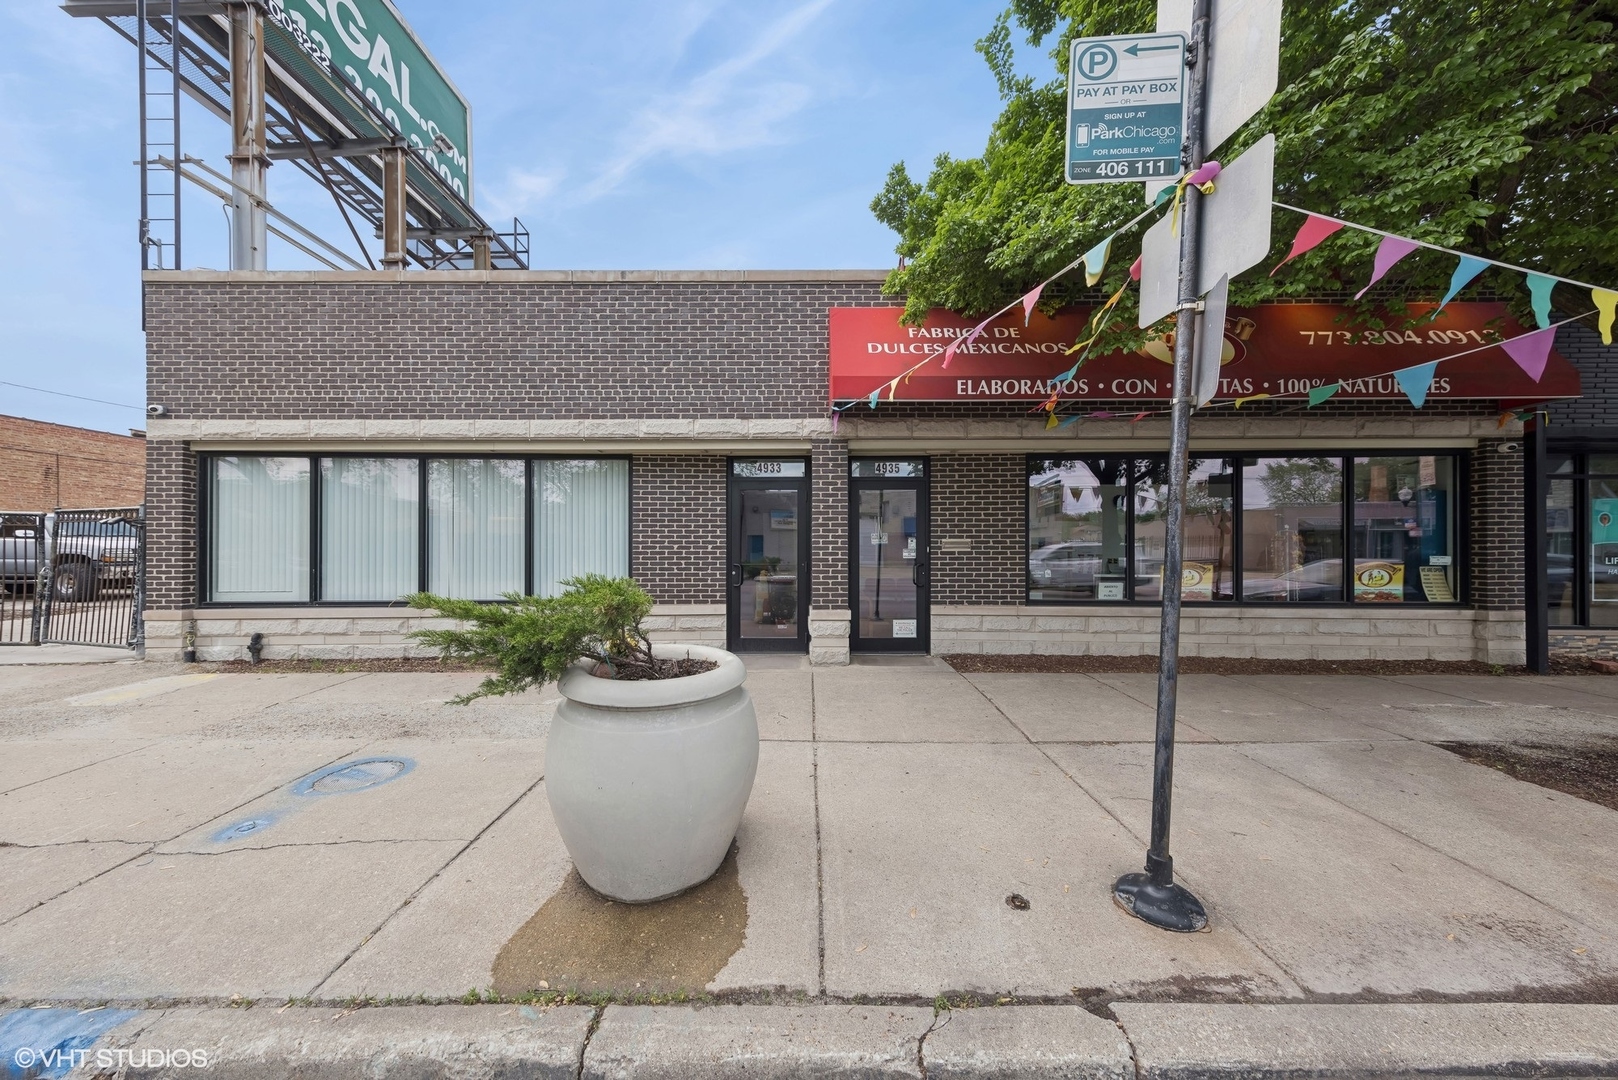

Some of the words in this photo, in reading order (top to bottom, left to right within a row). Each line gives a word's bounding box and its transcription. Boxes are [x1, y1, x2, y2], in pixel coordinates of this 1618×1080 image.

[1077, 87, 1101, 98] PAY
[1102, 86, 1118, 96] AT
[1121, 84, 1146, 95] PAY
[1149, 82, 1177, 93] BOX
[1091, 125, 1176, 140] ParkChicago
[1096, 161, 1129, 176] 406
[1135, 160, 1165, 175] 111
[908, 327, 989, 338] FABRICA
[994, 327, 1021, 338] DE
[1299, 329, 1506, 345] 773.804.091
[867, 343, 944, 354] DULCES
[954, 343, 1068, 354] MEXICANOS
[956, 379, 1089, 395] ELABORADOS
[1111, 378, 1158, 395] CON
[1338, 377, 1451, 394] NATURES
[757, 462, 782, 474] 4933
[875, 463, 900, 474] 4935
